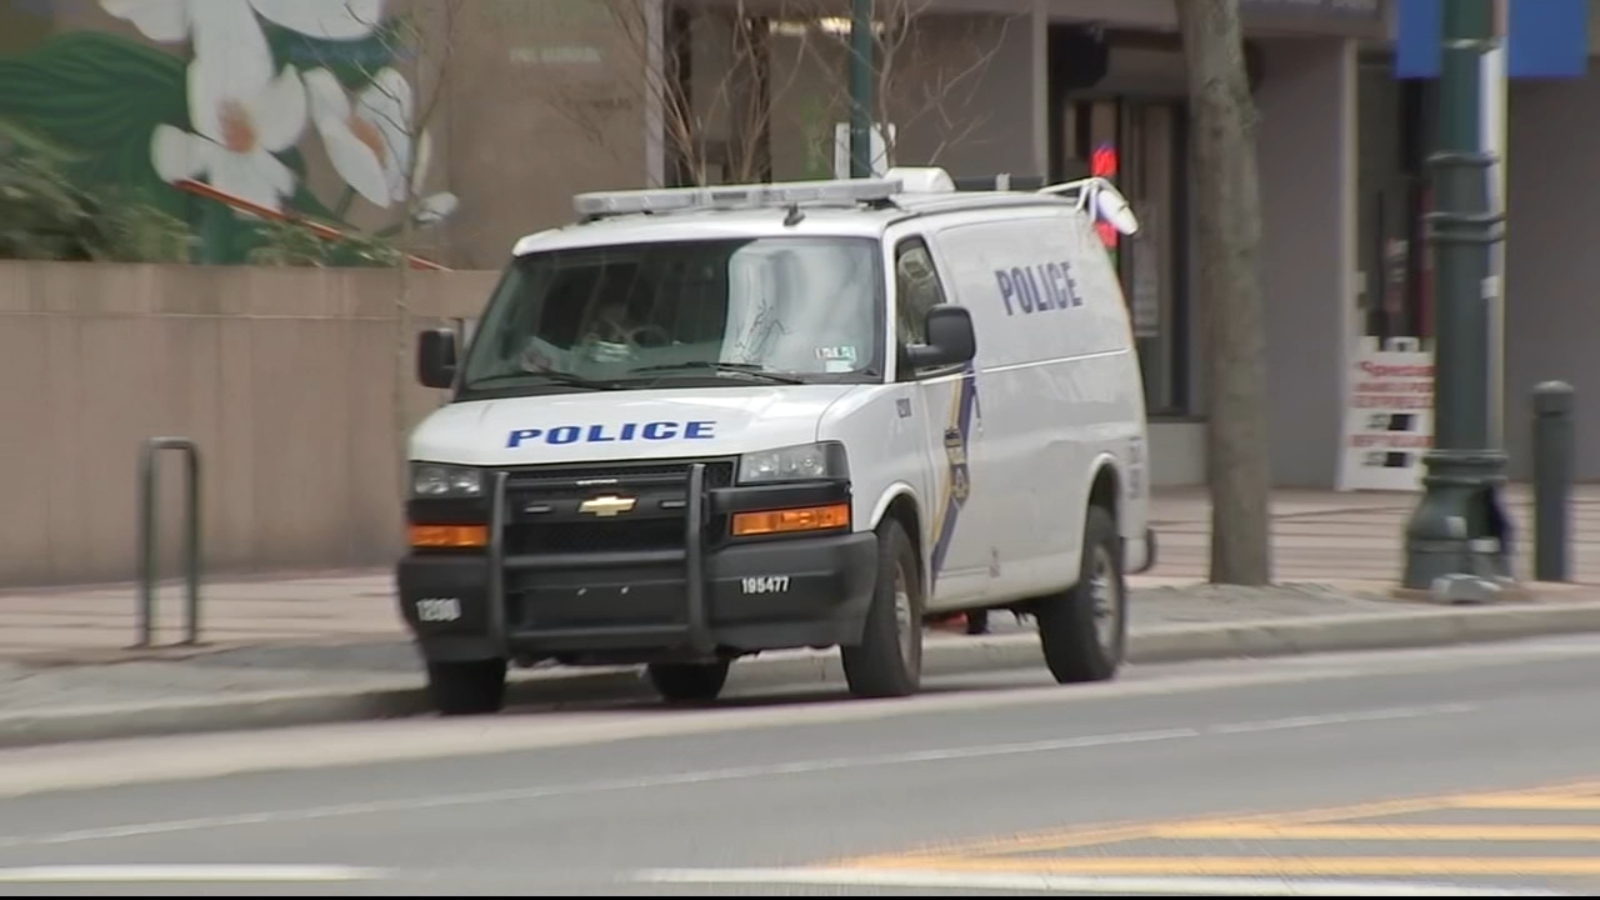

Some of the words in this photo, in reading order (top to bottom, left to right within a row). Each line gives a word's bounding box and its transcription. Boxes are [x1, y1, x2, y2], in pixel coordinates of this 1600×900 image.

[994, 262, 1083, 316] POLICE
[506, 421, 717, 448] POLICE
[742, 576, 789, 594] 195477
